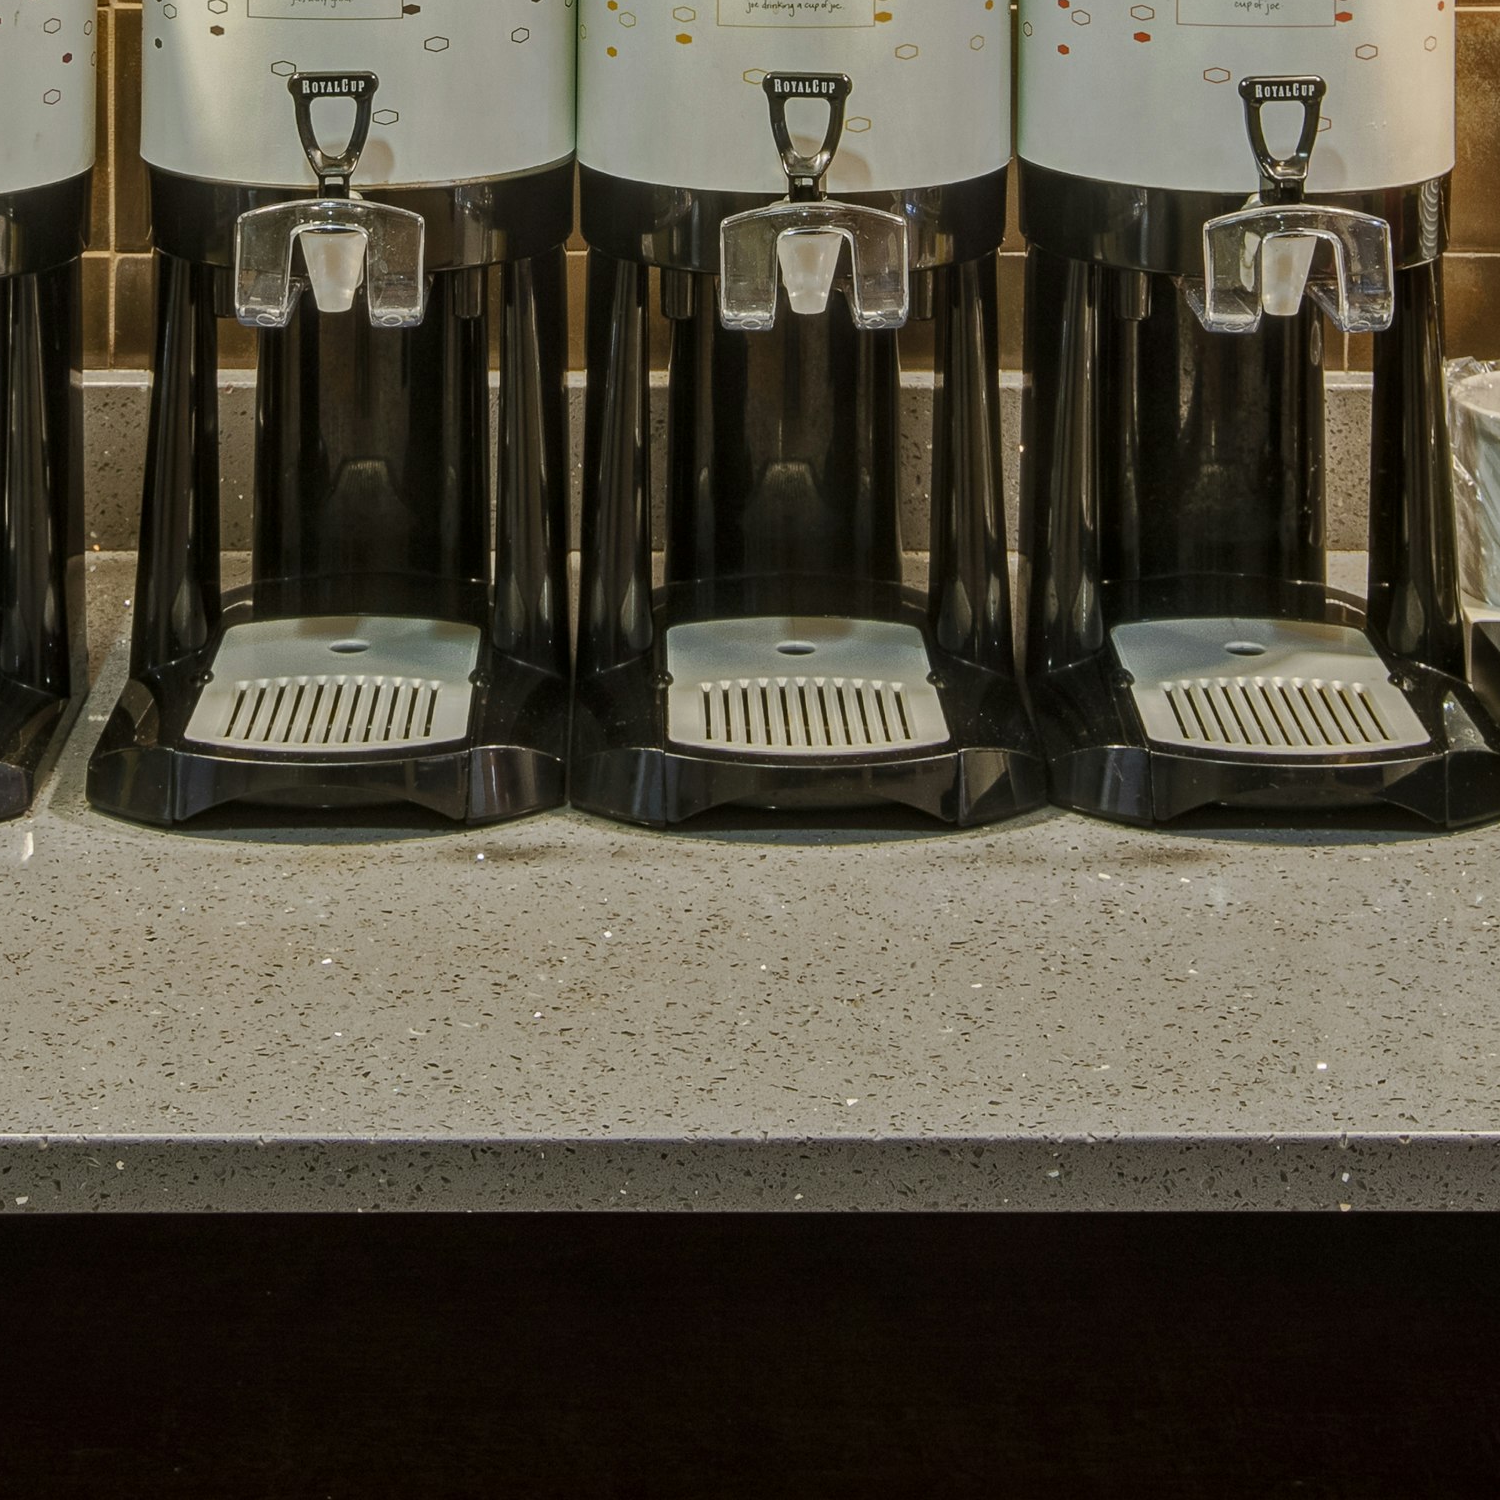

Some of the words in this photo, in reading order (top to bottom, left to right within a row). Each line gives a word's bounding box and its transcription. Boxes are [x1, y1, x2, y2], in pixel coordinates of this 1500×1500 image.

[745, 0, 759, 14] joe
[804, 2, 820, 12] cup
[1234, 0, 1252, 12] cup
